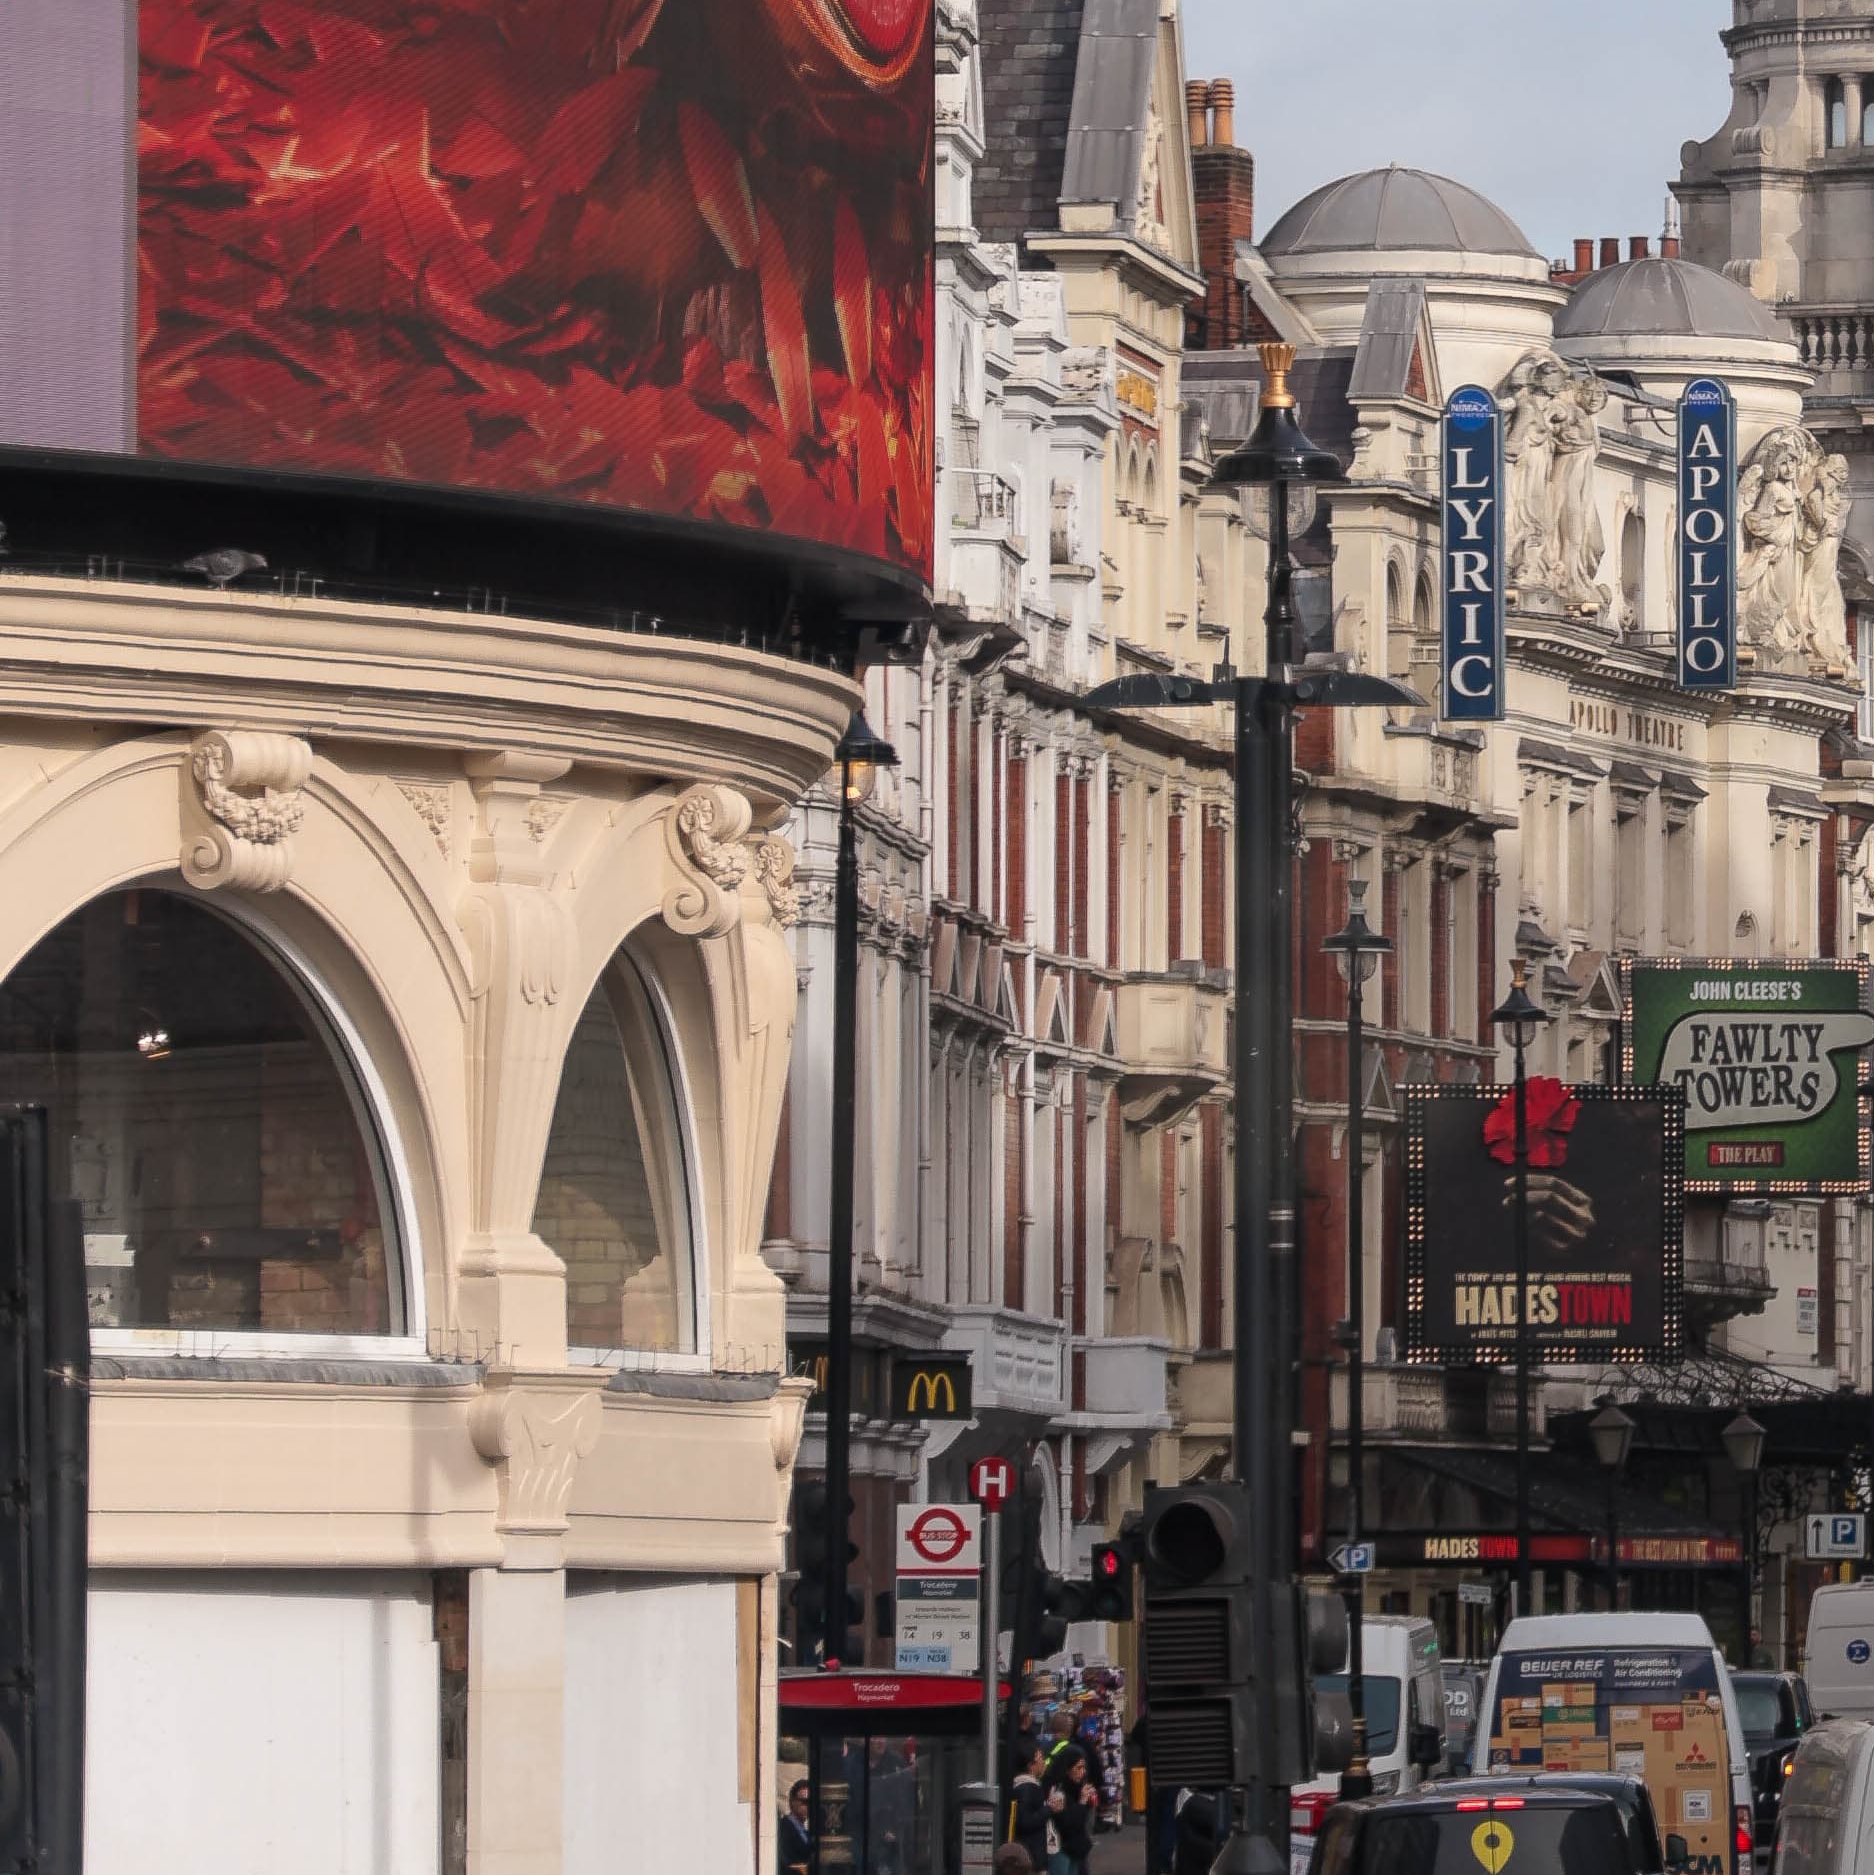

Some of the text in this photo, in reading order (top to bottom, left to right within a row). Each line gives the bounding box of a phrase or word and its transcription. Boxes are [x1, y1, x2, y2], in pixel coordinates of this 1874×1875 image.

[1685, 424, 1724, 672] APOLLO
[1448, 448, 1493, 697] LYRIC
[1569, 700, 1683, 751] APOLLO THEATRE
[1690, 980, 1802, 1001] JOHN CLEESE'S
[1690, 1023, 1824, 1065] FAWLTY
[1673, 1065, 1820, 1114] TOWERS
[1718, 1146, 1776, 1163] THE PLAY
[979, 1465, 1007, 1498] H
[1836, 1521, 1854, 1543] P
[1425, 1537, 1519, 1559] HADESTOWN
[931, 1630, 943, 1640] 19
[959, 1631, 970, 1640] 38
[899, 1654, 947, 1663] N19 N38
[1573, 1659, 1605, 1671] REF
[1614, 1667, 1683, 1679] Air Conditioning
[853, 1683, 900, 1692] Trocadero
